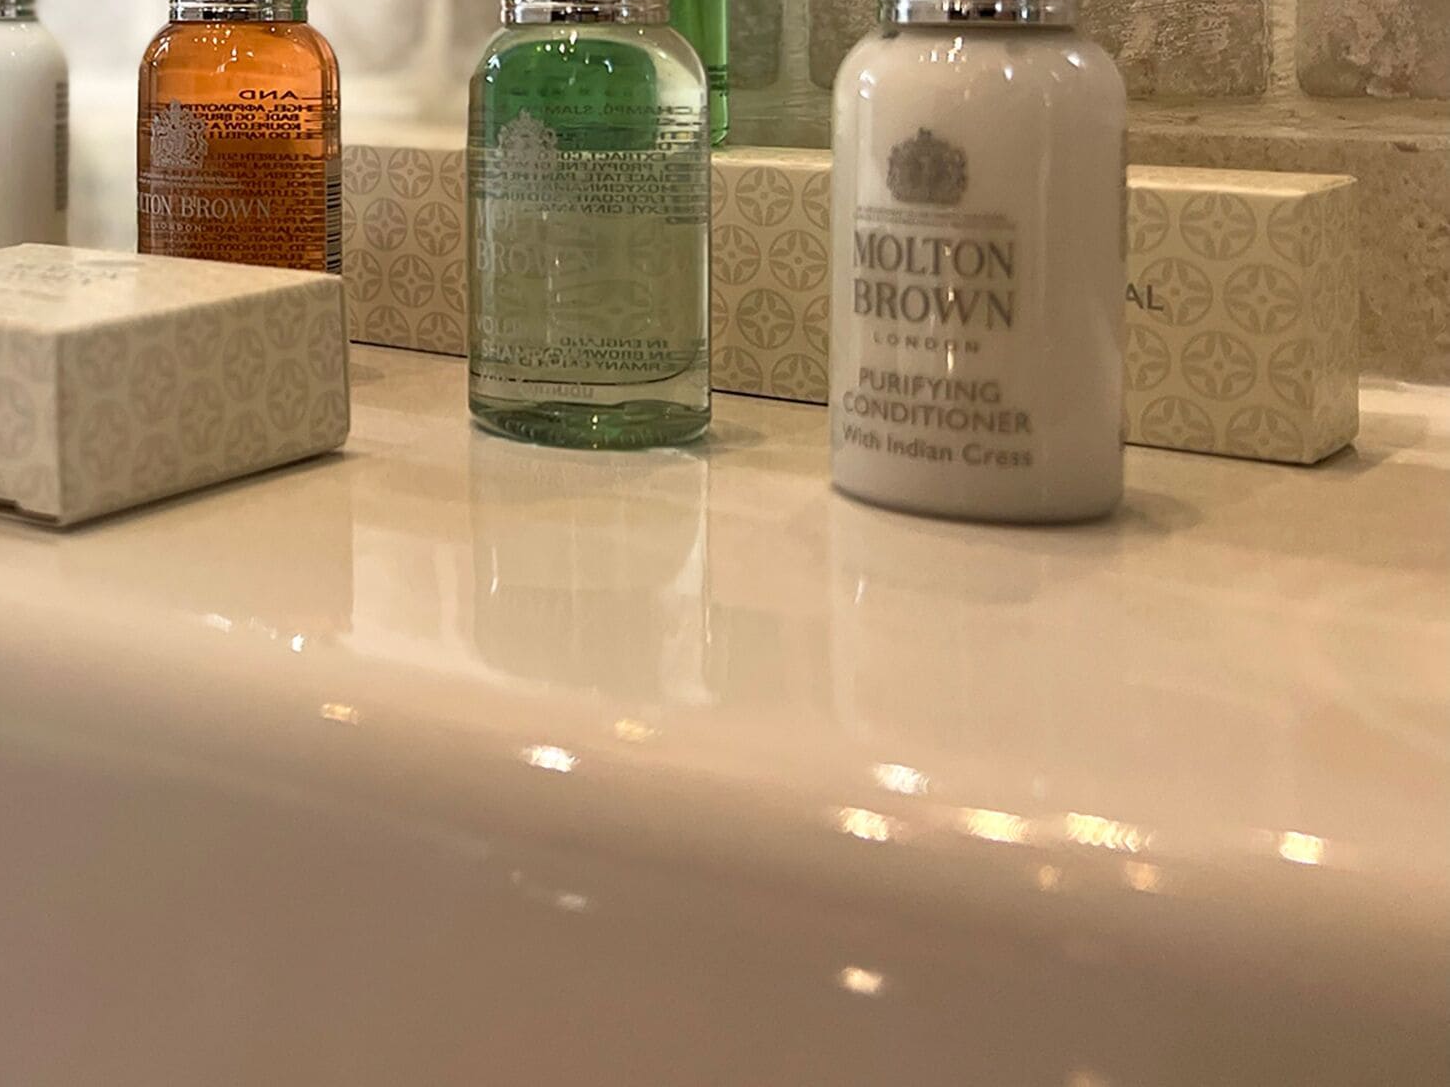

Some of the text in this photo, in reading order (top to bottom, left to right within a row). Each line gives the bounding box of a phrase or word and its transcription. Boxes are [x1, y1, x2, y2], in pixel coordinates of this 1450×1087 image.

[180, 196, 272, 219] BROWN
[853, 229, 1014, 280] MOLTON
[853, 278, 1014, 330] BROWN
[873, 330, 980, 353] LONDON
[859, 367, 1001, 403] PURIFYING
[842, 390, 1032, 433] CONDITIONER
[843, 423, 1033, 466] With Indian Cress
